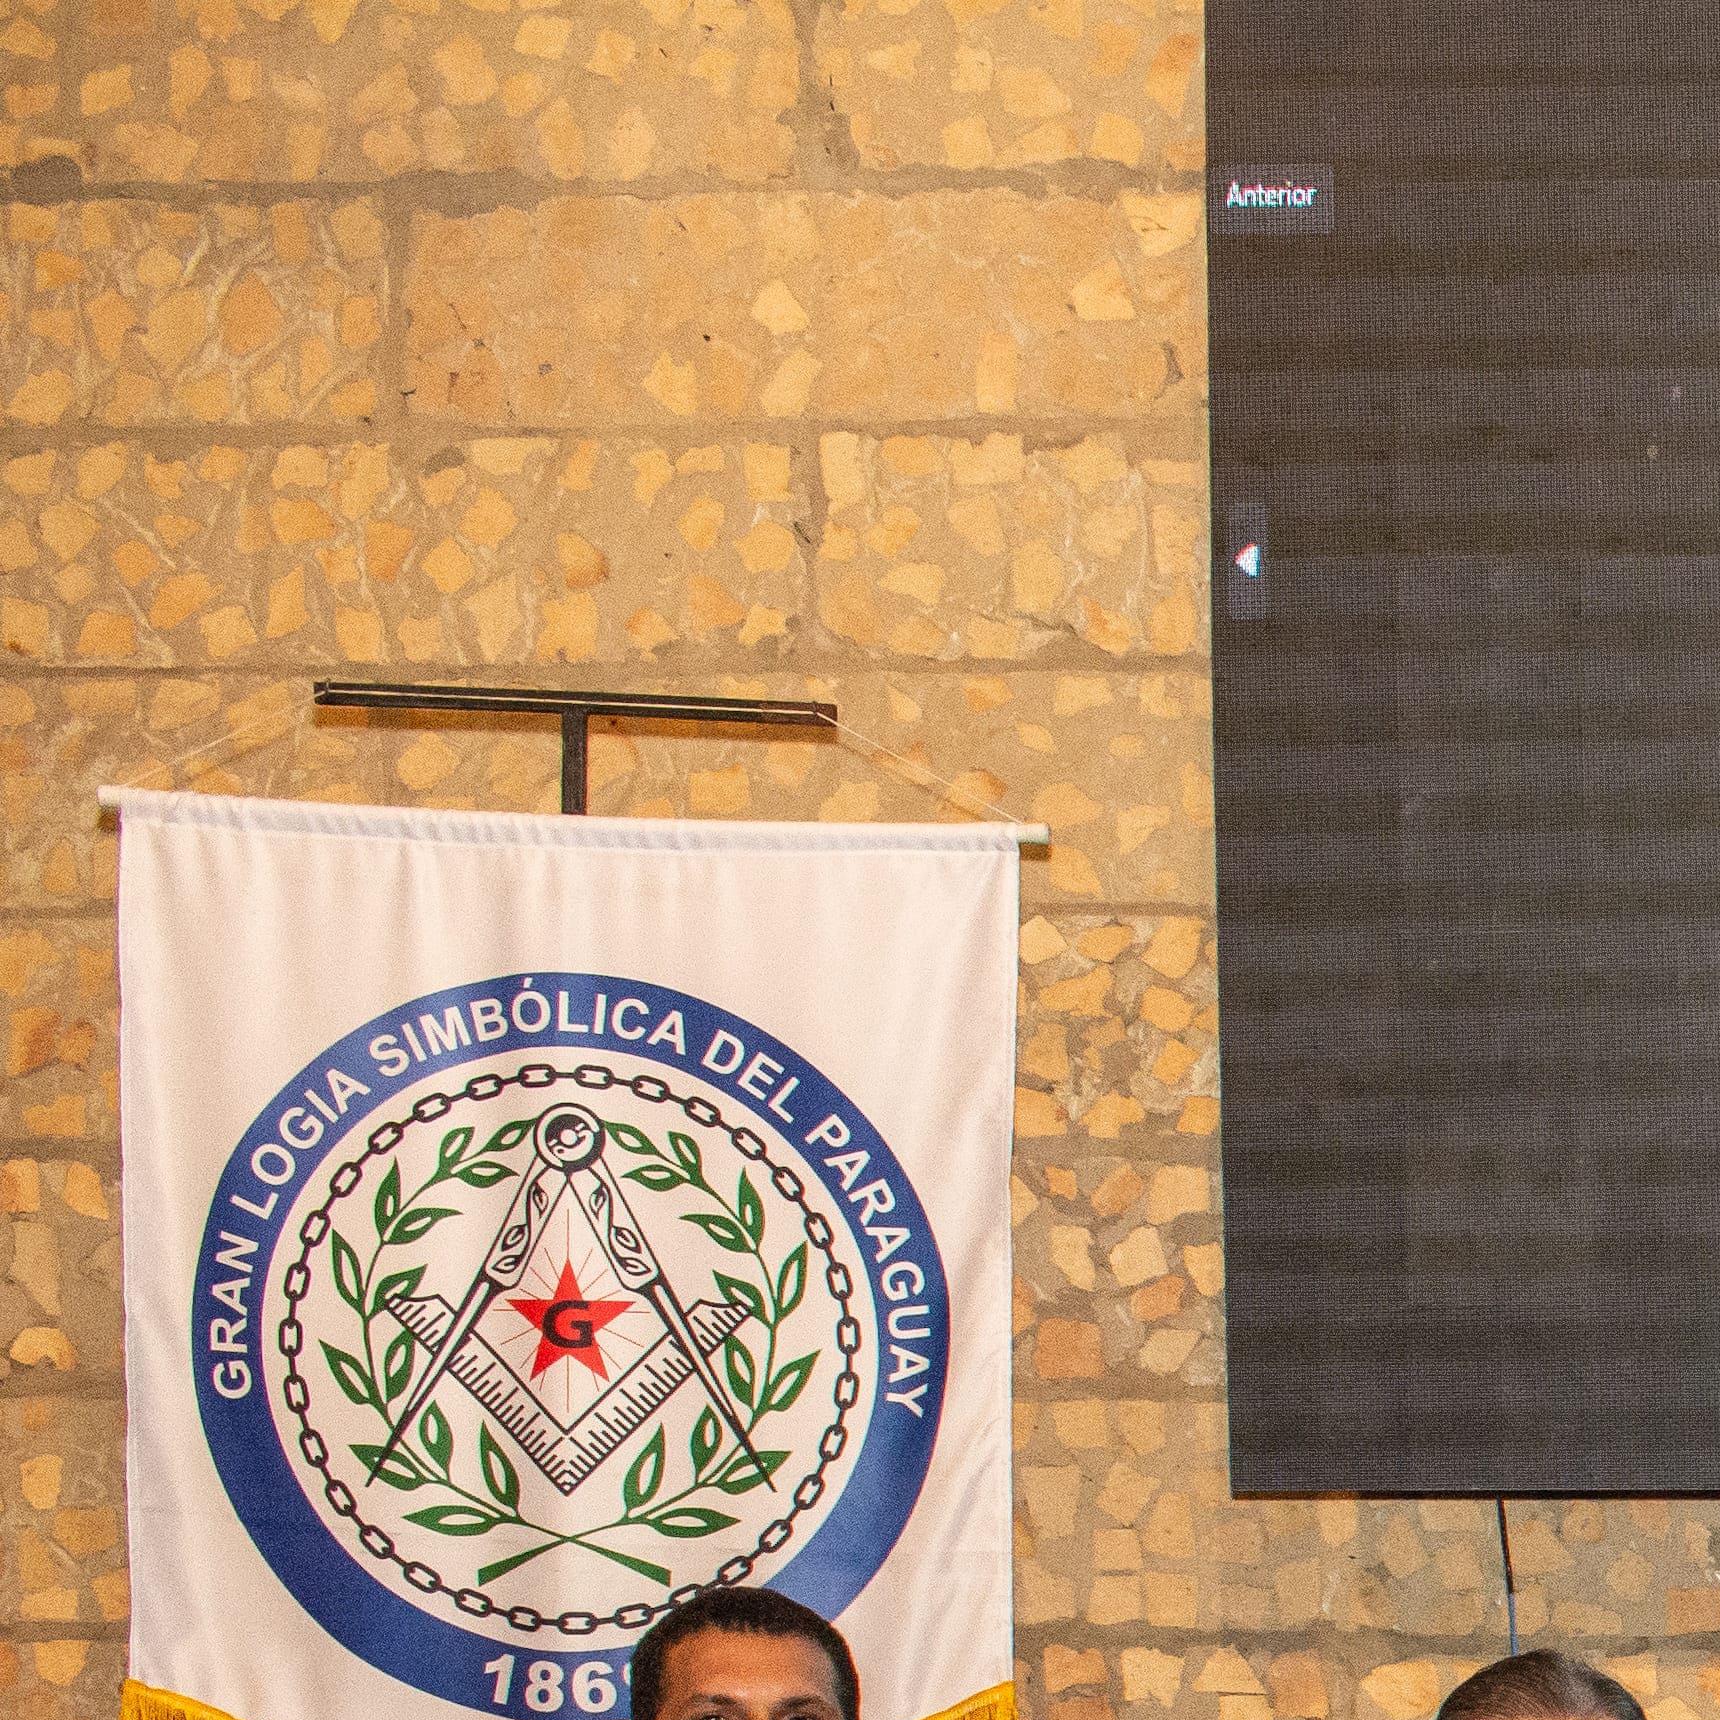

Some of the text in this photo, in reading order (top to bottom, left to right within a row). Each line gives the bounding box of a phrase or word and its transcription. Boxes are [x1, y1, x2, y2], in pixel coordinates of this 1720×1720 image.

[1226, 180, 1318, 208] Anterior
[210, 976, 932, 1419] GRAN LOGIA SIMBÓLICA DEL PARAGUAY
[542, 1300, 593, 1349] G
